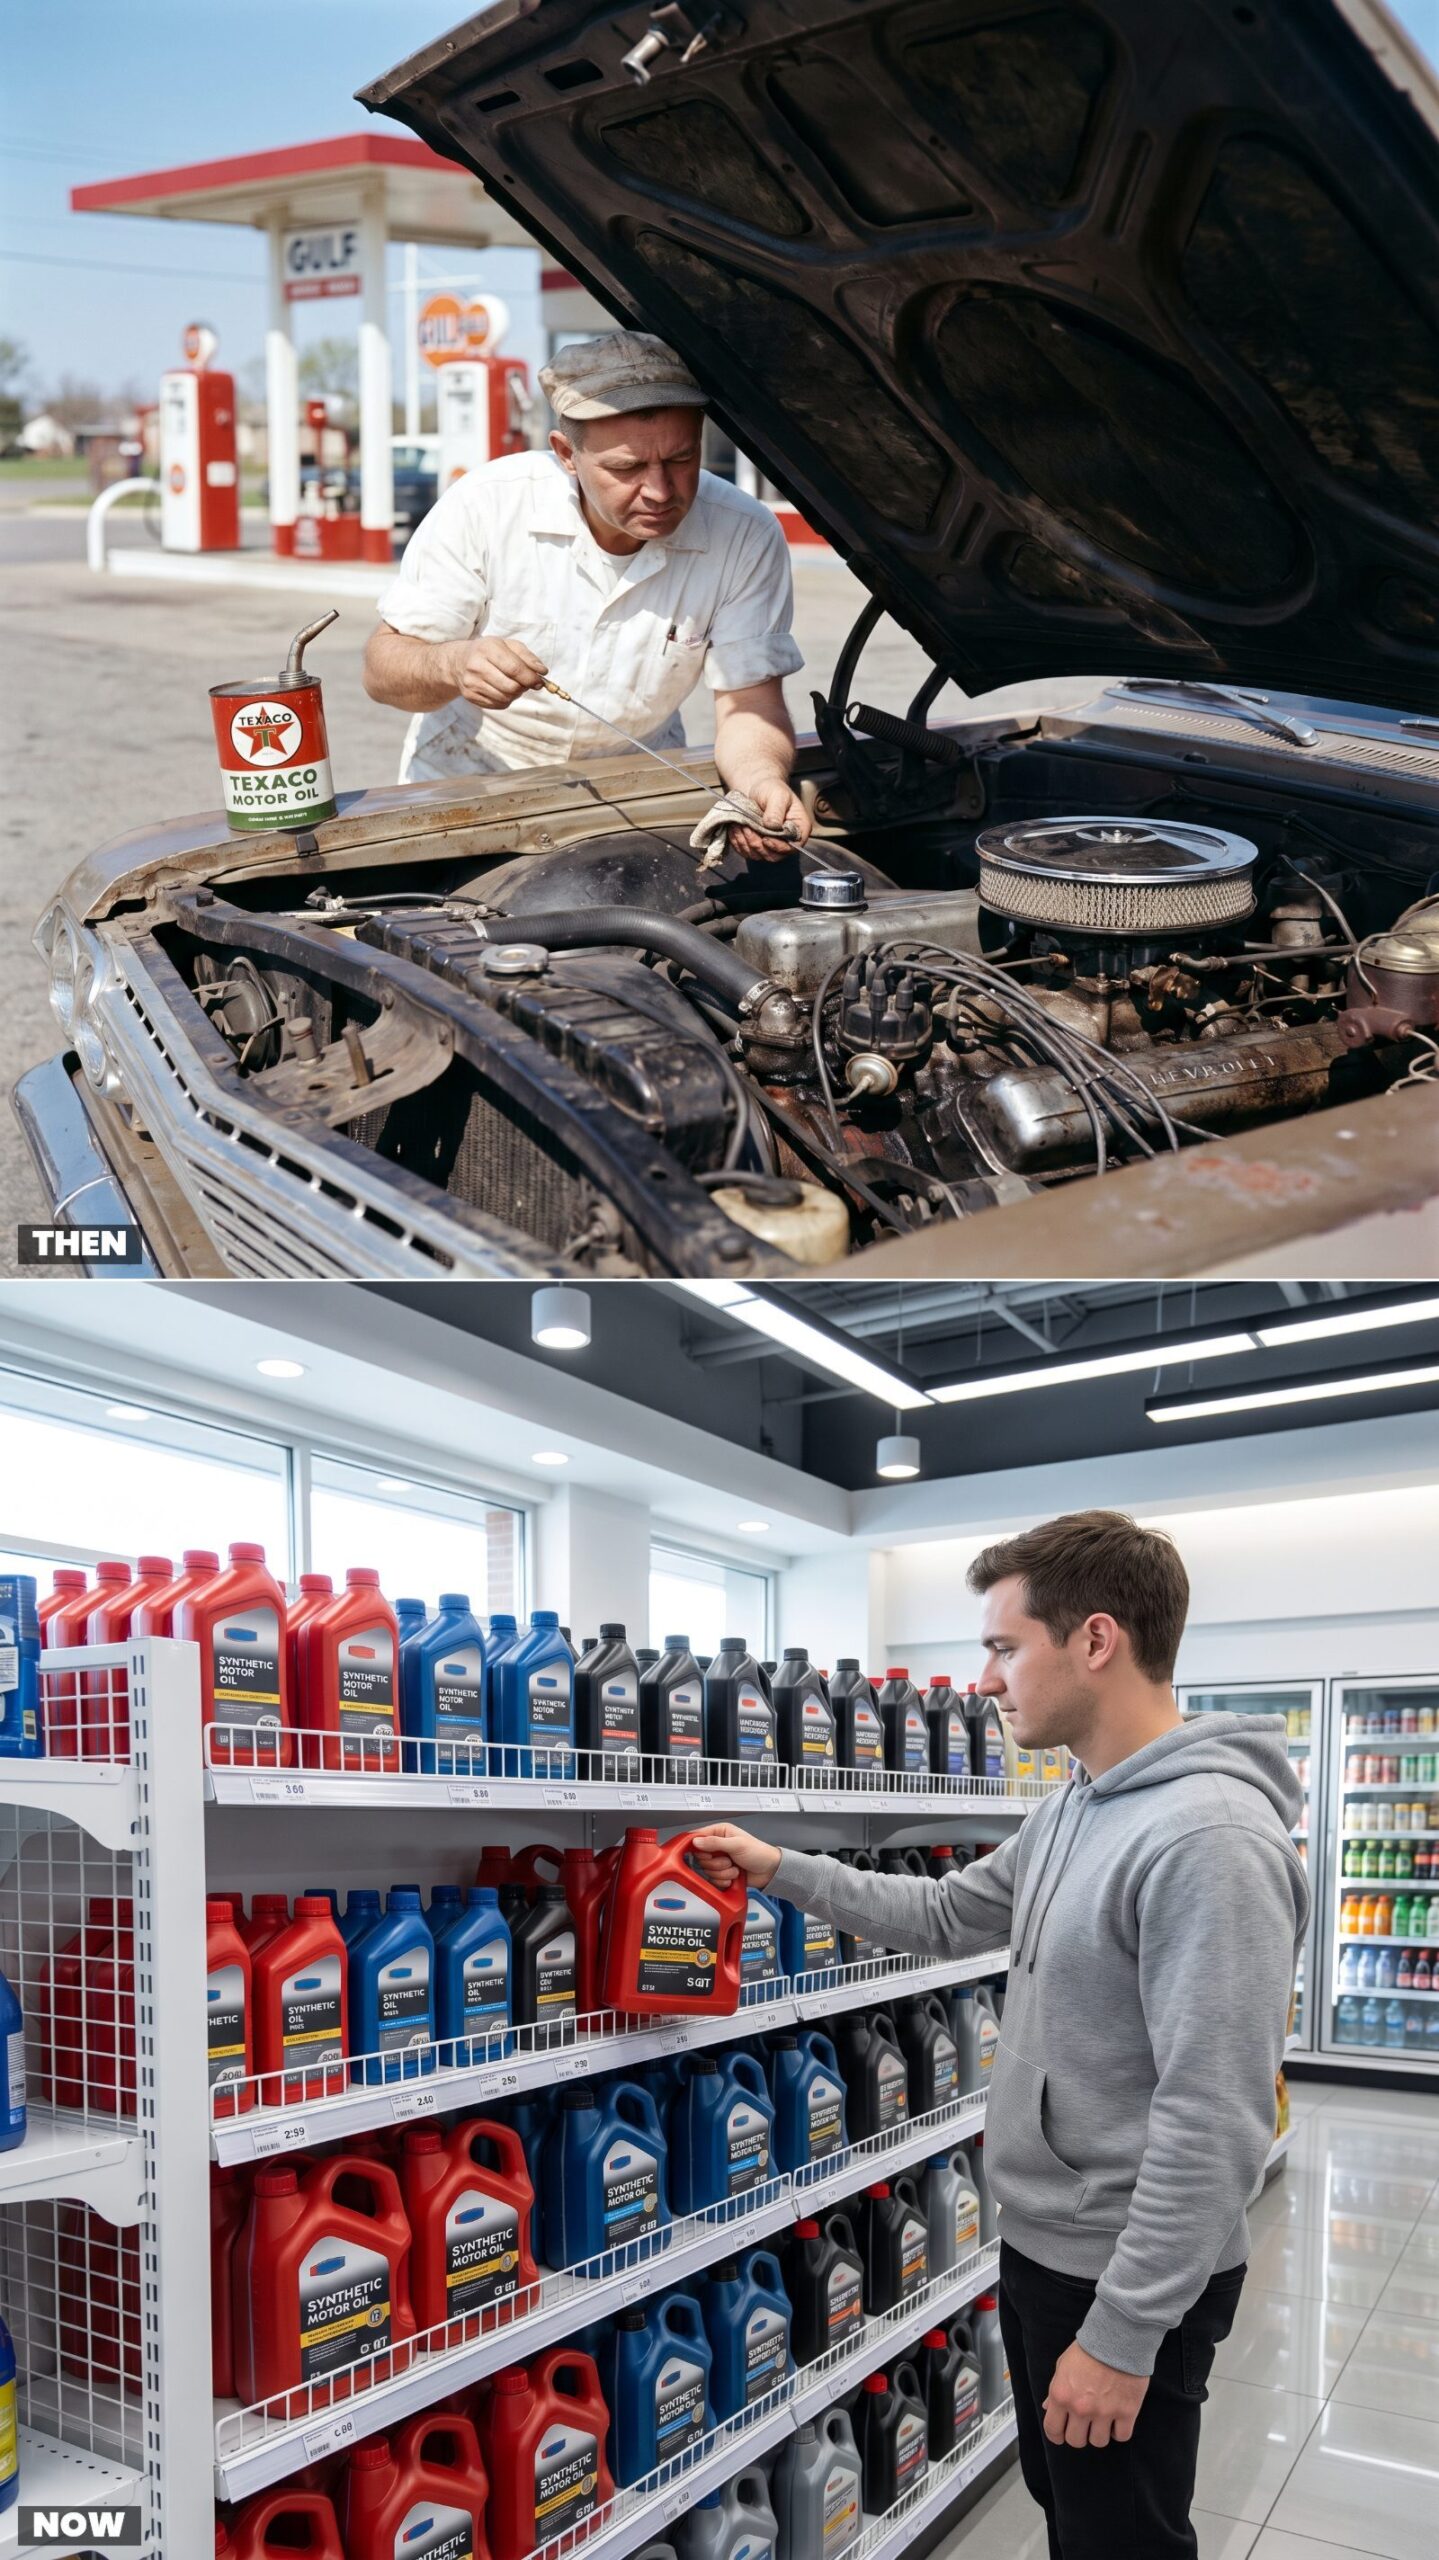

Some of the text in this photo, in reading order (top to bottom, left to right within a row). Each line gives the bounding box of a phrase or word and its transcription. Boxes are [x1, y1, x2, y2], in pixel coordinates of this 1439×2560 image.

[288, 231, 356, 272] GULF
[239, 712, 292, 726] TEXACO
[253, 728, 276, 747] T
[230, 768, 317, 791] TEXACO
[233, 788, 319, 806] MOTOR OIL
[1150, 1054, 1276, 1086] HEVROLET
[219, 1656, 275, 1670] SYNTHETIC
[219, 1666, 255, 1678] MOTOR
[219, 1675, 238, 1685] OIL
[343, 1671, 389, 1683] SYNTHETIC
[343, 1680, 373, 1690] MOTOR
[343, 1688, 358, 1698] OIL
[439, 1703, 453, 1712] OIL
[648, 1925, 712, 1938] SYNTHETIC
[647, 1935, 706, 1947] MOTOR OIL
[383, 1988, 425, 2002] SYNTHETIC
[288, 2001, 336, 2015] SYNTHETIC
[383, 2001, 397, 2010] OIL
[208, 2015, 239, 2026] HETIC
[288, 2015, 304, 2024] OIL
[607, 2173, 654, 2198] SYNTHETIC
[607, 2187, 648, 2208] MOTOR OIL
[451, 2227, 514, 2258] SYNTHETIC
[451, 2243, 505, 2269] MOTOR OIL
[307, 2277, 383, 2313] SYNTHETIC
[307, 2296, 372, 2325] MOTOR OIL
[659, 2383, 702, 2416] SYNTHETIC
[659, 2404, 685, 2425] MOTOR
[540, 2451, 592, 2490] SYNTHETIC
[540, 2469, 585, 2500] MOTOR OIL
